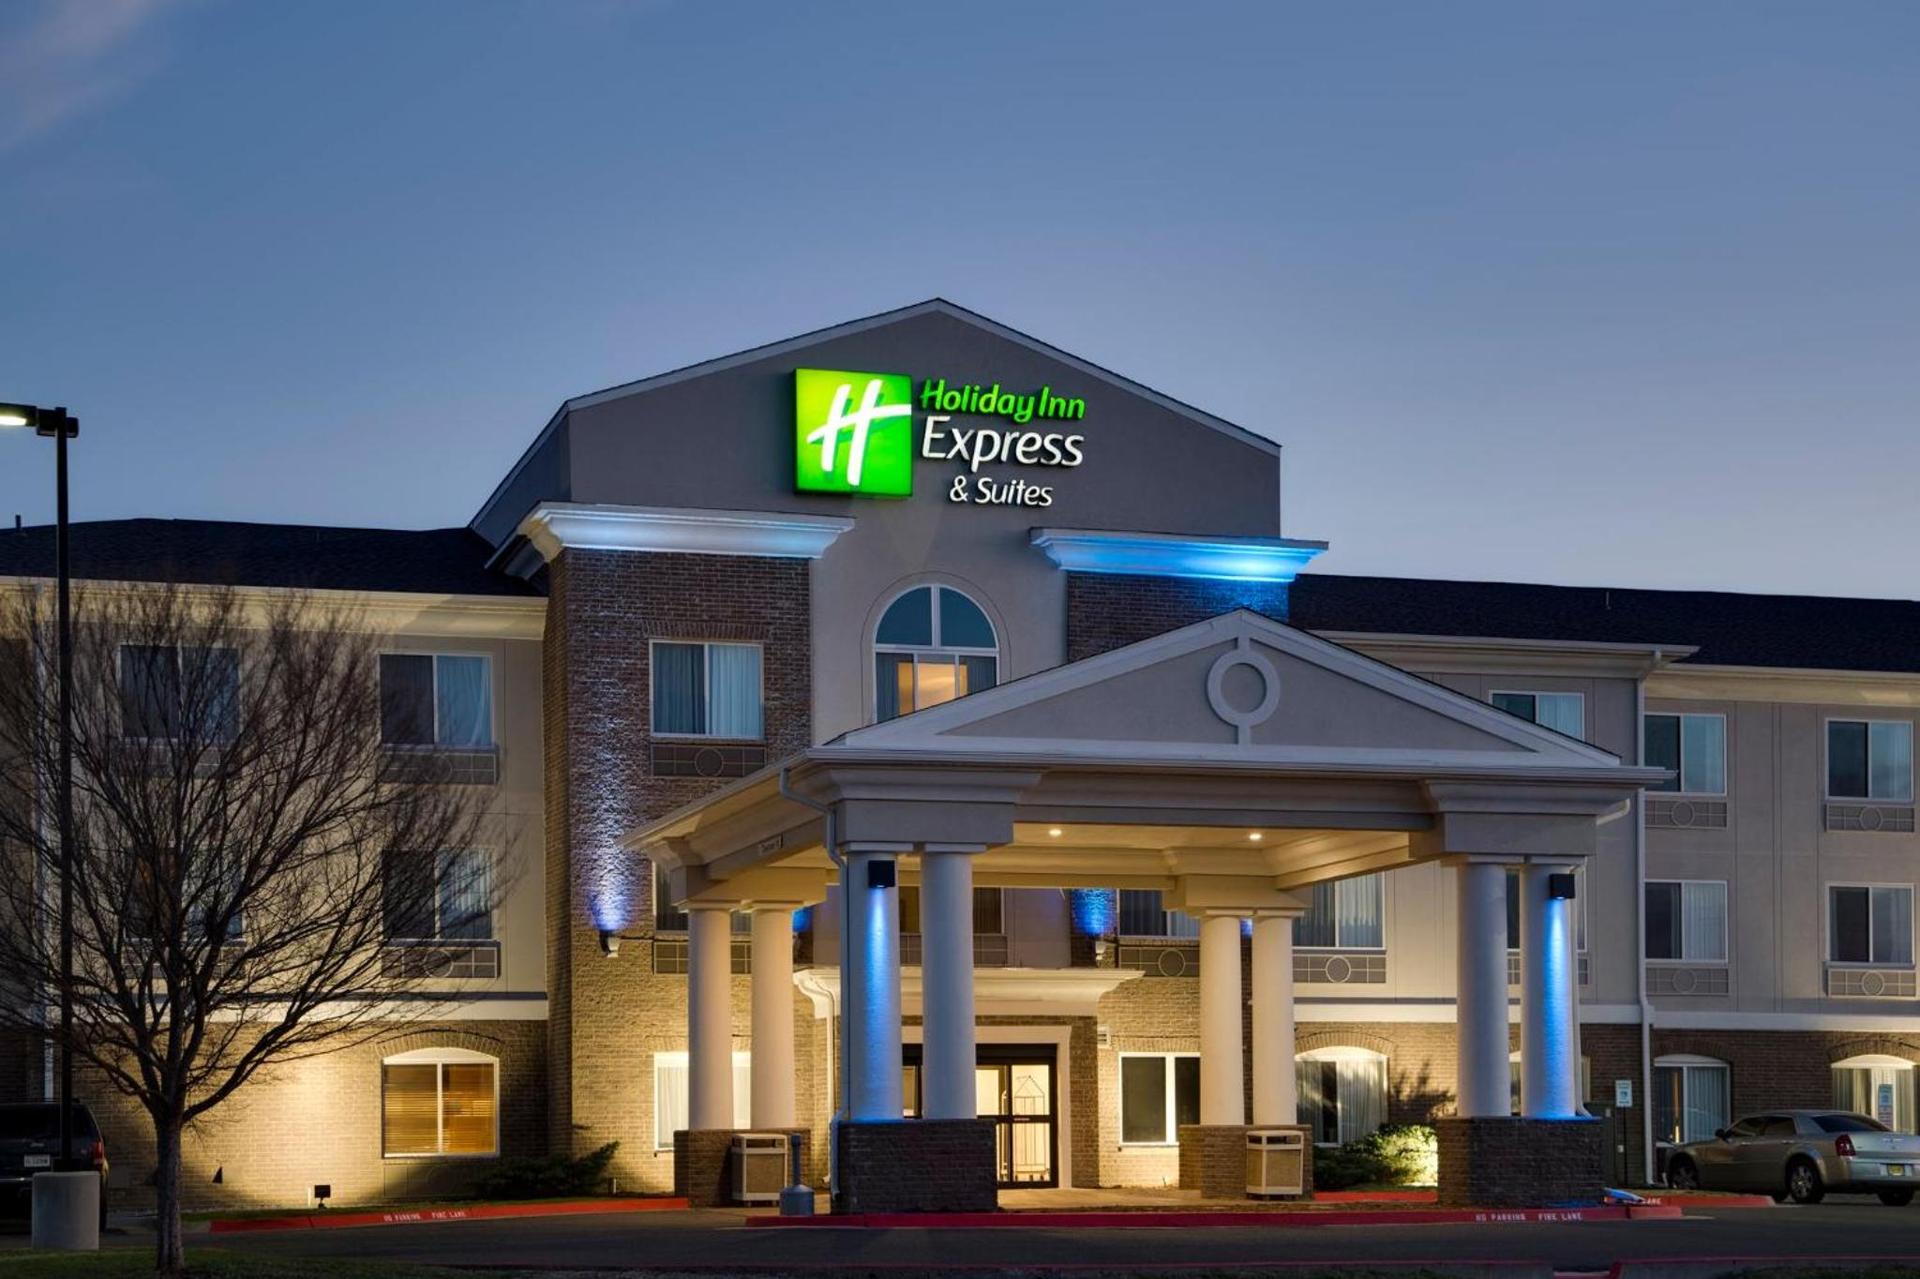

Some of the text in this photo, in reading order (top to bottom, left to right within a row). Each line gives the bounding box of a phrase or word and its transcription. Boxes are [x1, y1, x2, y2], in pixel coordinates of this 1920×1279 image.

[920, 379, 1086, 423] Holiday Inn
[922, 416, 1085, 473] Express
[950, 475, 1053, 507] & Suites
